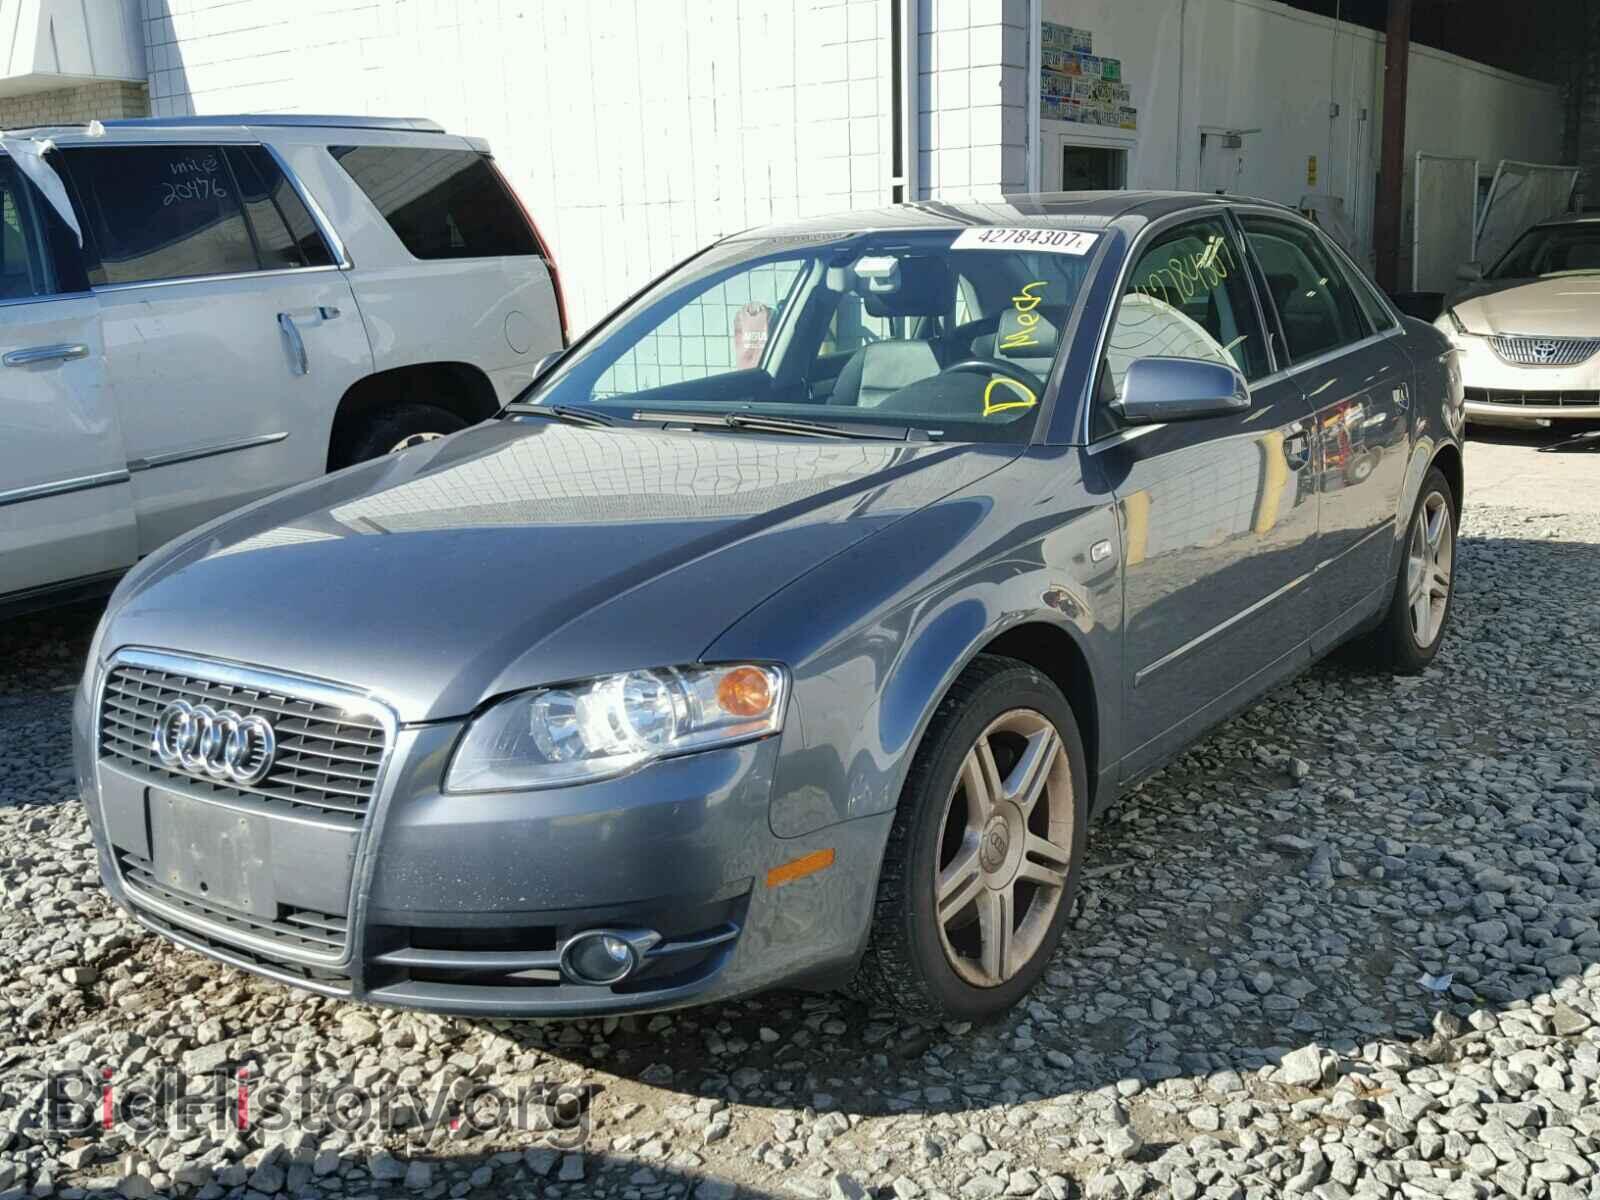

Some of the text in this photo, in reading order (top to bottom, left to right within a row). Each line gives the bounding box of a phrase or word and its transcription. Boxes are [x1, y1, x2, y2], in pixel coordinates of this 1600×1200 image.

[160, 176, 227, 206] 20476
[978, 228, 1081, 247] 42784307
[1000, 281, 1049, 348] Mech
[983, 378, 1038, 417] D
